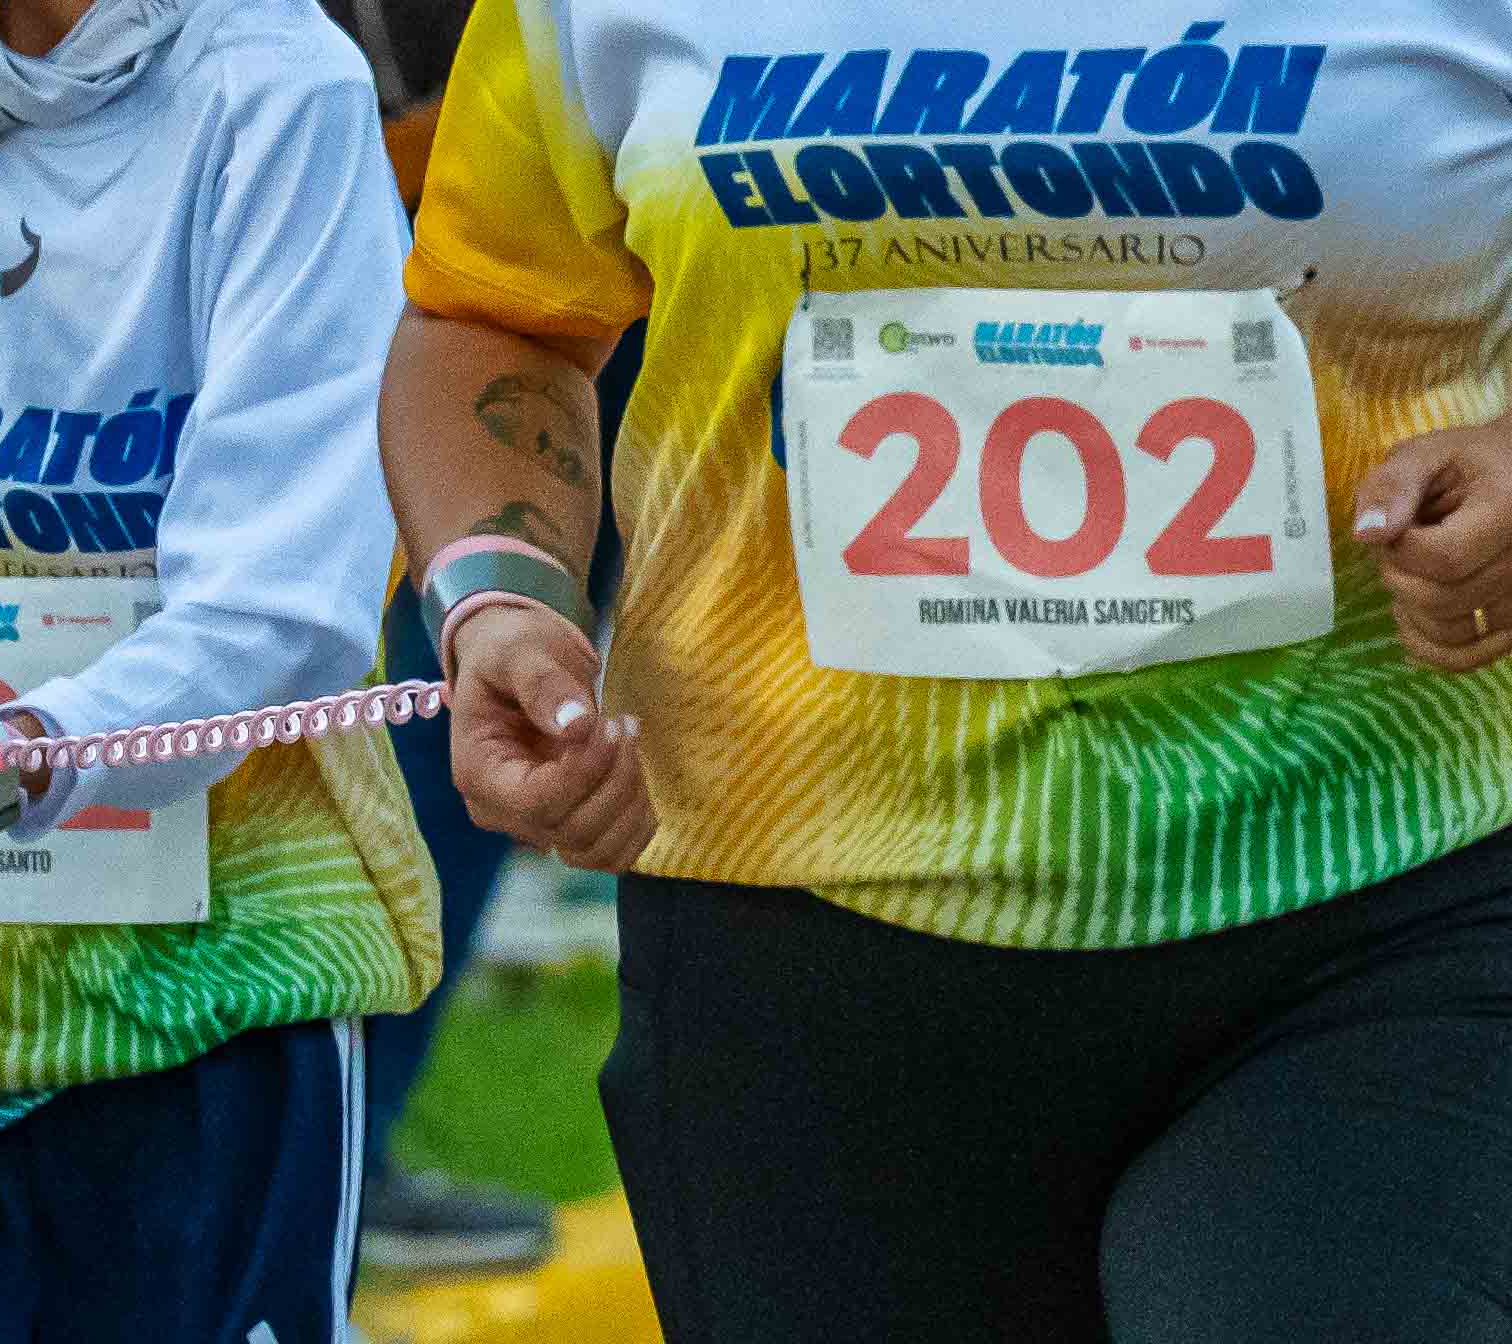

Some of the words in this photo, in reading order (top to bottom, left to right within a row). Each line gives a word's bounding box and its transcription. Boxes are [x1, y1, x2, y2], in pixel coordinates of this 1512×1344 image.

[695, 20, 1326, 146] MARATÓN
[698, 141, 1325, 228] ELORTONDO
[802, 239, 863, 271] 137
[884, 233, 1207, 267] ANIVERSARIO
[838, 391, 1274, 578] 202
[919, 598, 1000, 625] ROMINA
[1004, 598, 1089, 625] VALERIA
[1093, 598, 1195, 626] SANGENIS
